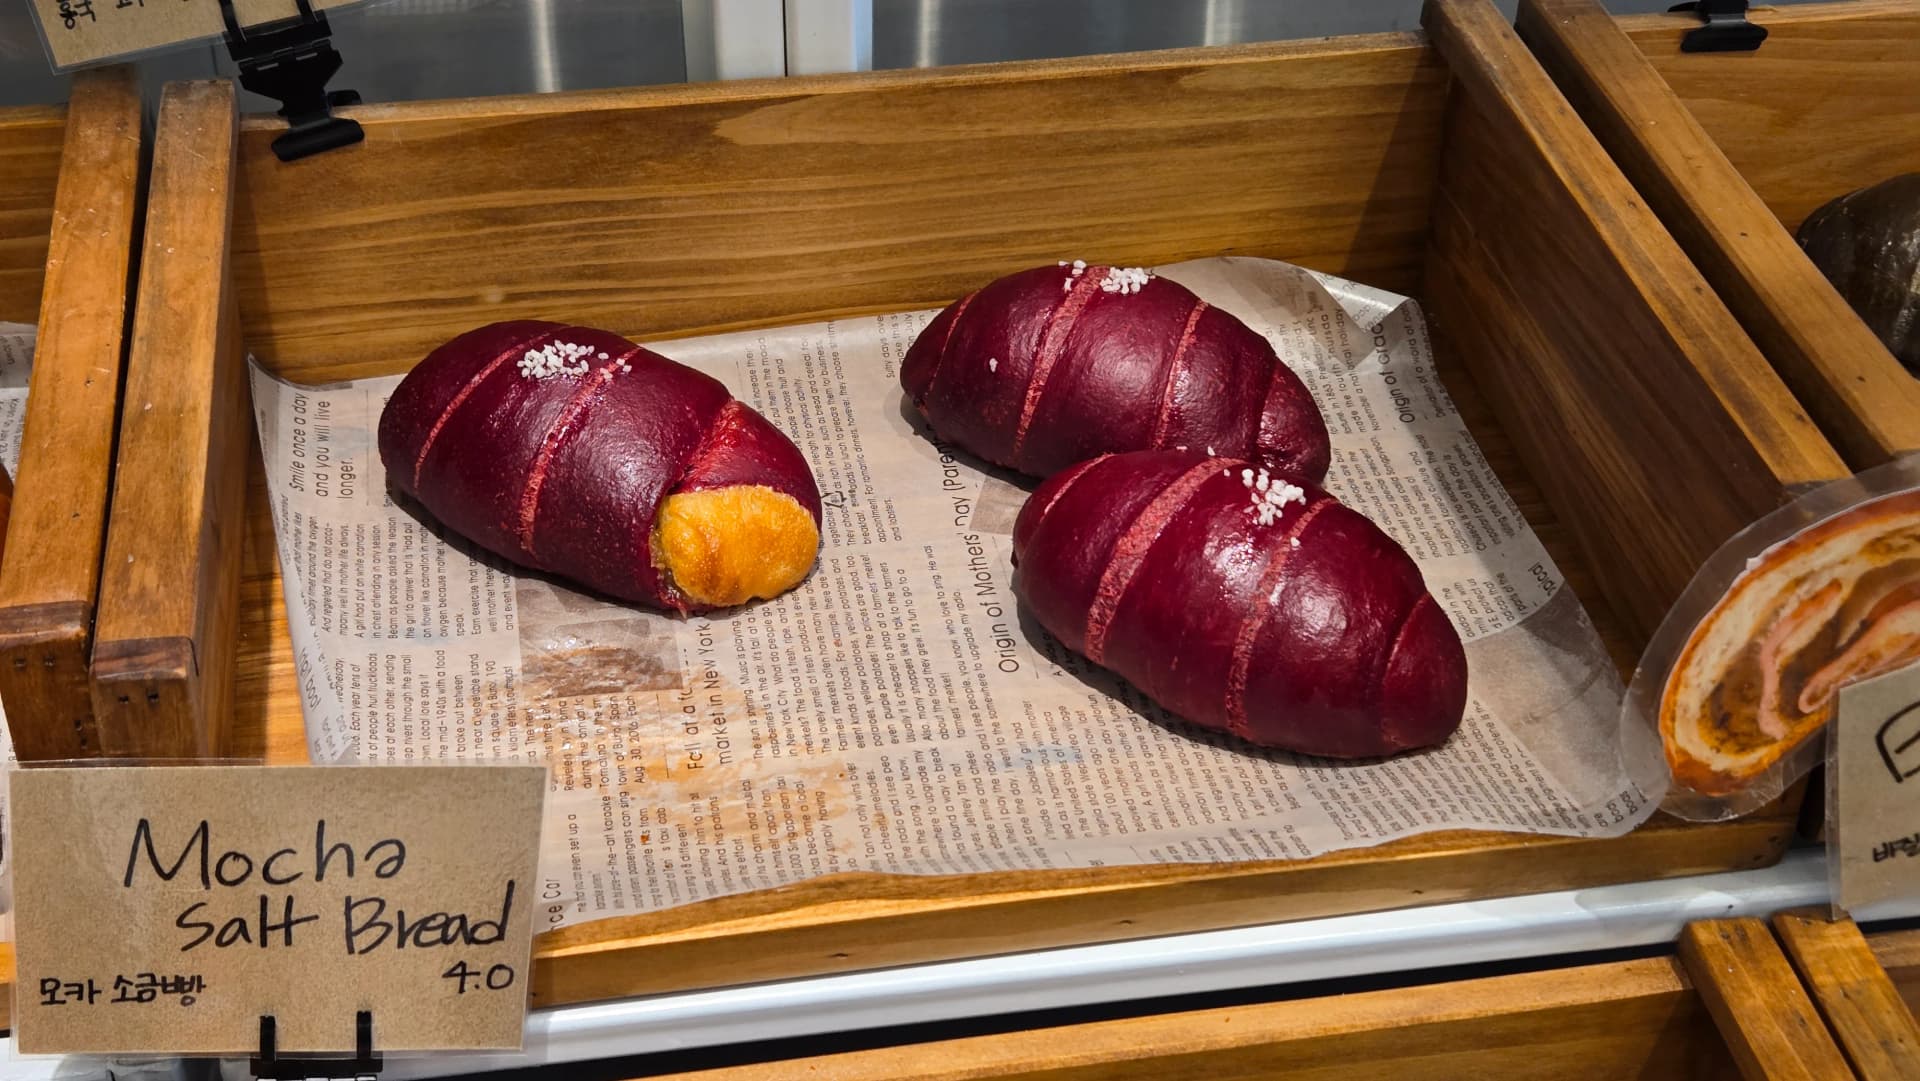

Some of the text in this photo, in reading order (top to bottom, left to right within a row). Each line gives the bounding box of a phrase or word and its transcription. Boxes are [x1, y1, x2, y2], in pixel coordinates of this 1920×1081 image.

[1368, 322, 1415, 423] Origin of crac
[1359, 396, 1381, 431] November
[289, 393, 309, 492] Smile once a day
[312, 401, 331, 497] and you will live
[336, 458, 356, 499] longer.
[890, 527, 902, 541] and
[956, 532, 997, 596] Mothers'
[979, 602, 1003, 618] of
[846, 553, 900, 744] even purple potatoes! The prices are good, too.
[991, 623, 1020, 673] Origin
[401, 655, 414, 722] through the small
[682, 705, 696, 714] a
[695, 623, 733, 766] market in New York
[681, 722, 700, 735] at
[684, 742, 704, 770] Fall
[601, 796, 614, 832] karaoke
[124, 819, 406, 890] Mocha
[621, 810, 638, 875] passengers can
[176, 879, 515, 955] Salt Bread
[40, 972, 207, 1007] 모카 소금빵
[442, 960, 515, 995] 4.0
